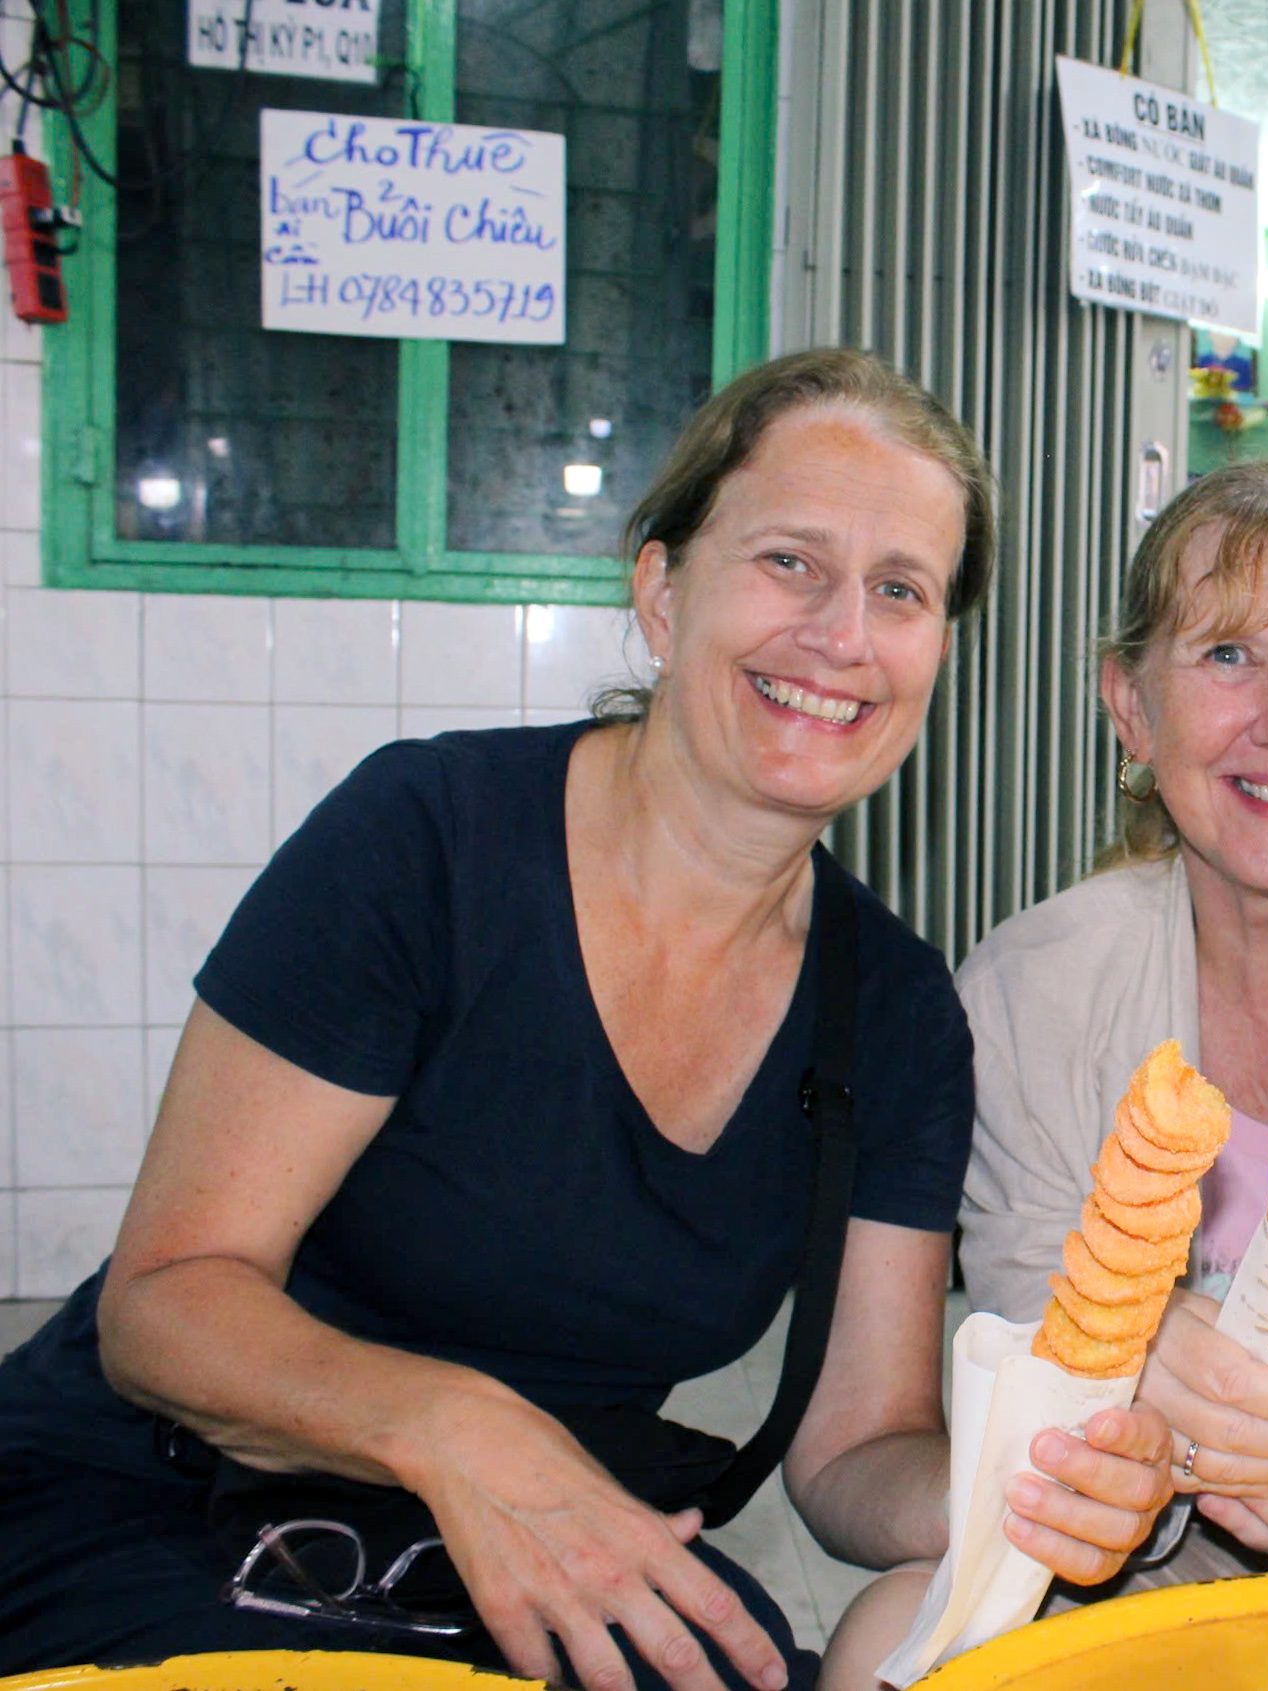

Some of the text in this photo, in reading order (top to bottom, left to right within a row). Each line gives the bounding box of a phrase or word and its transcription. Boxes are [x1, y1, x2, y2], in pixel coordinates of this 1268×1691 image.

[1133, 89, 1206, 142] CÓ BÁN
[288, 118, 399, 166] Cho
[331, 180, 432, 243] Buổi
[280, 271, 555, 322] LH 0784835719
